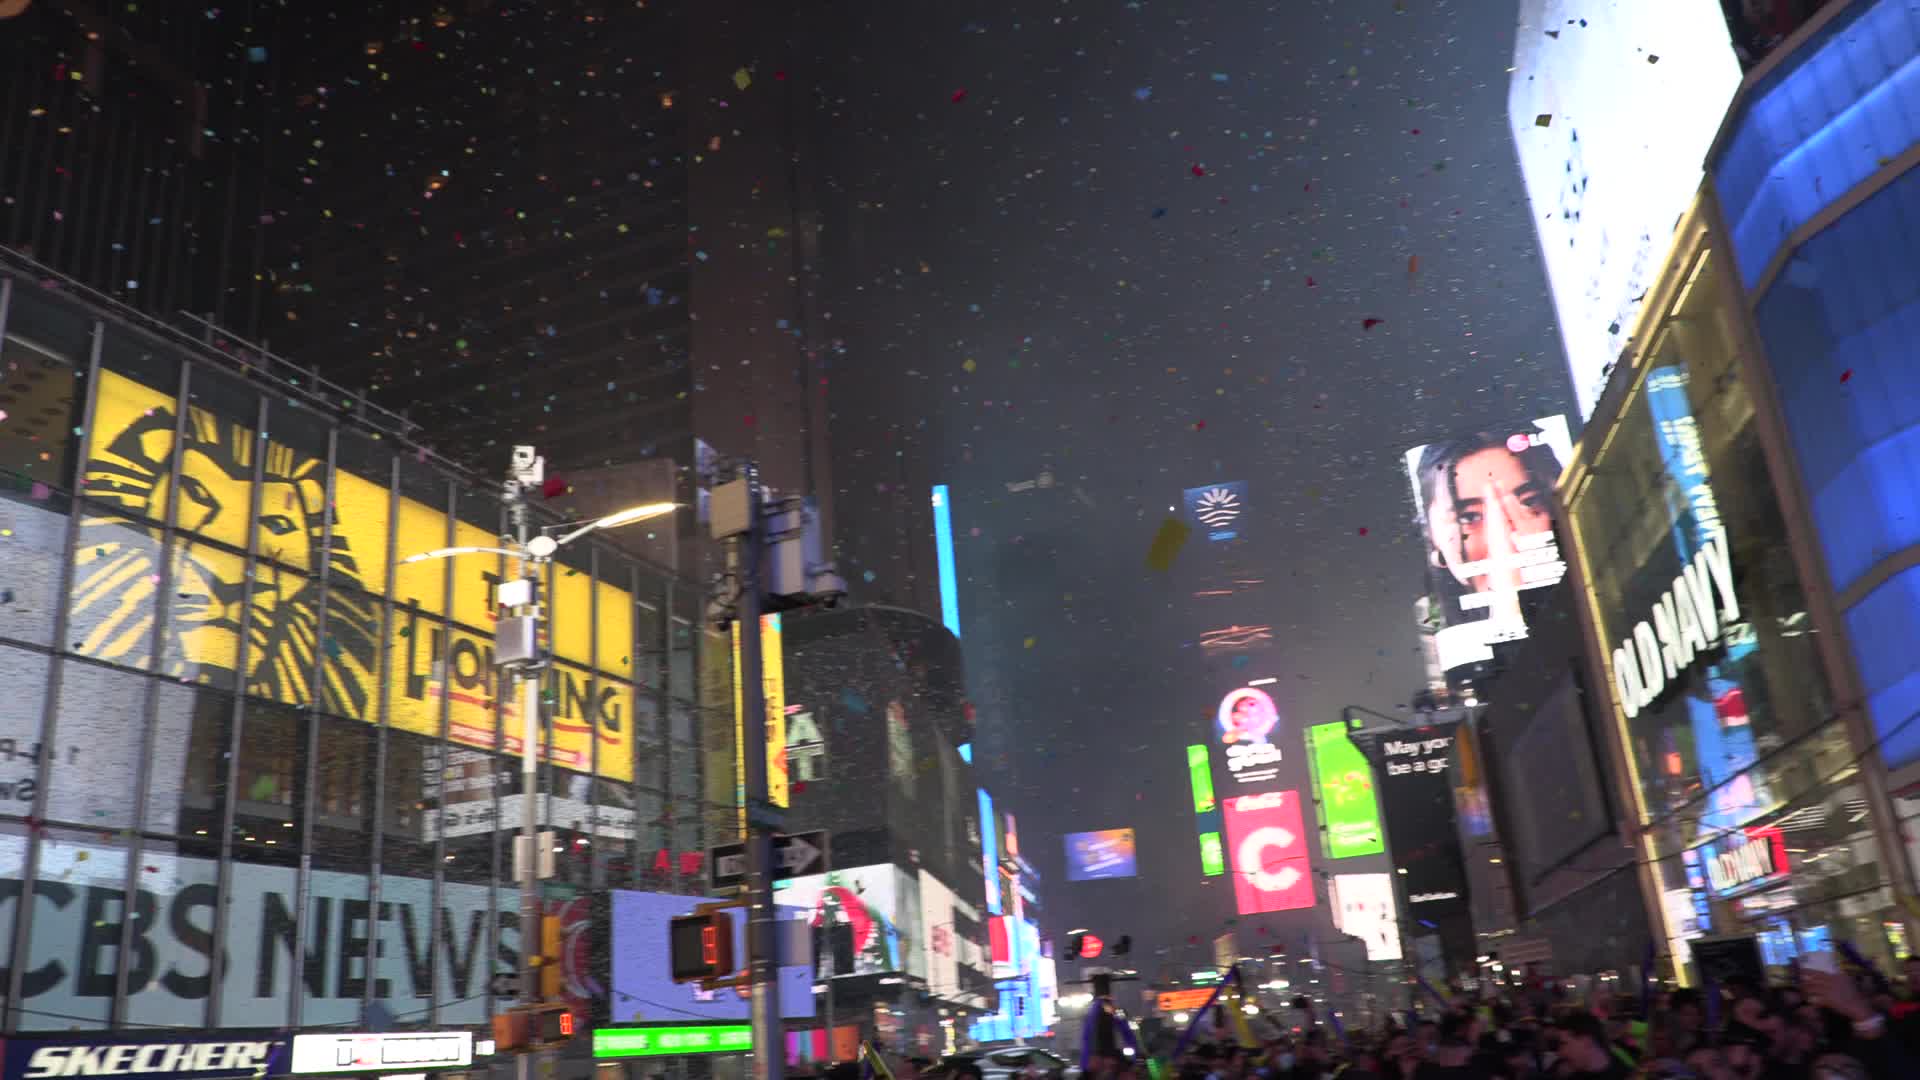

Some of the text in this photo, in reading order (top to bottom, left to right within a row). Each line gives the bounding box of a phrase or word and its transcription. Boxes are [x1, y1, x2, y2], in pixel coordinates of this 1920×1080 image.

[1613, 621, 1664, 718] OLD
[1652, 525, 1740, 680] NAVY
[0, 878, 523, 1000] CBS NEWS
